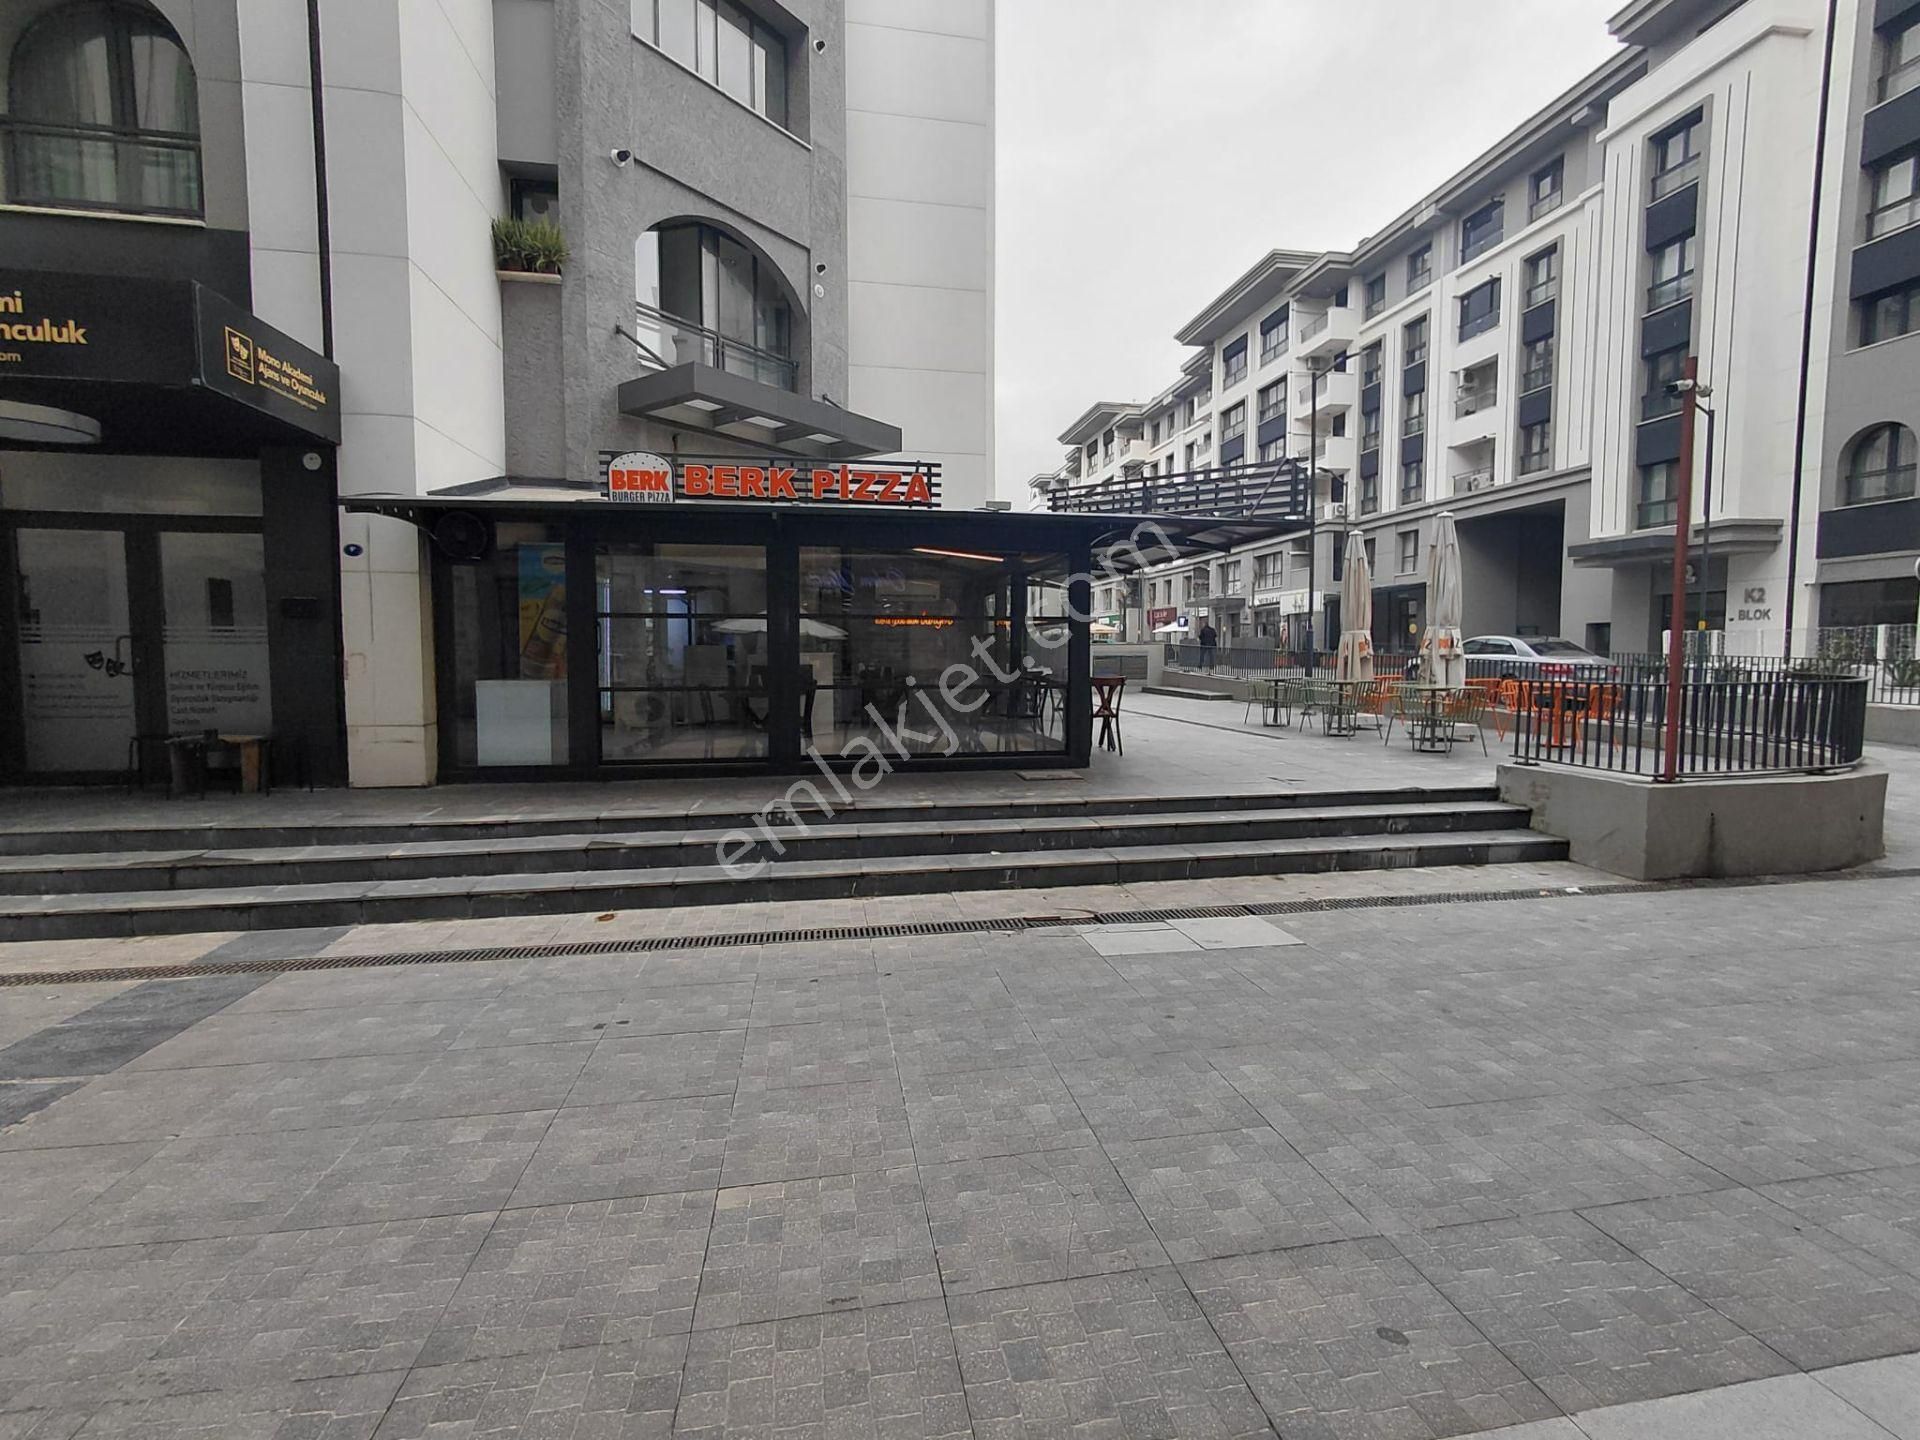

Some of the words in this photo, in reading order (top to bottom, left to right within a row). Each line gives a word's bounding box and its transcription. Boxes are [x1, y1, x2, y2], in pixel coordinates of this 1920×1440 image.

[257, 347, 281, 368] Mono
[281, 360, 313, 385] Akademi
[258, 362, 280, 382] Ajans
[291, 378, 327, 404] Oyunculuk
[610, 469, 670, 491] BERK
[684, 464, 798, 499] BERK
[612, 491, 645, 502] BURGER
[1744, 587, 1766, 604] K2
[1738, 608, 1771, 621] BLOK
